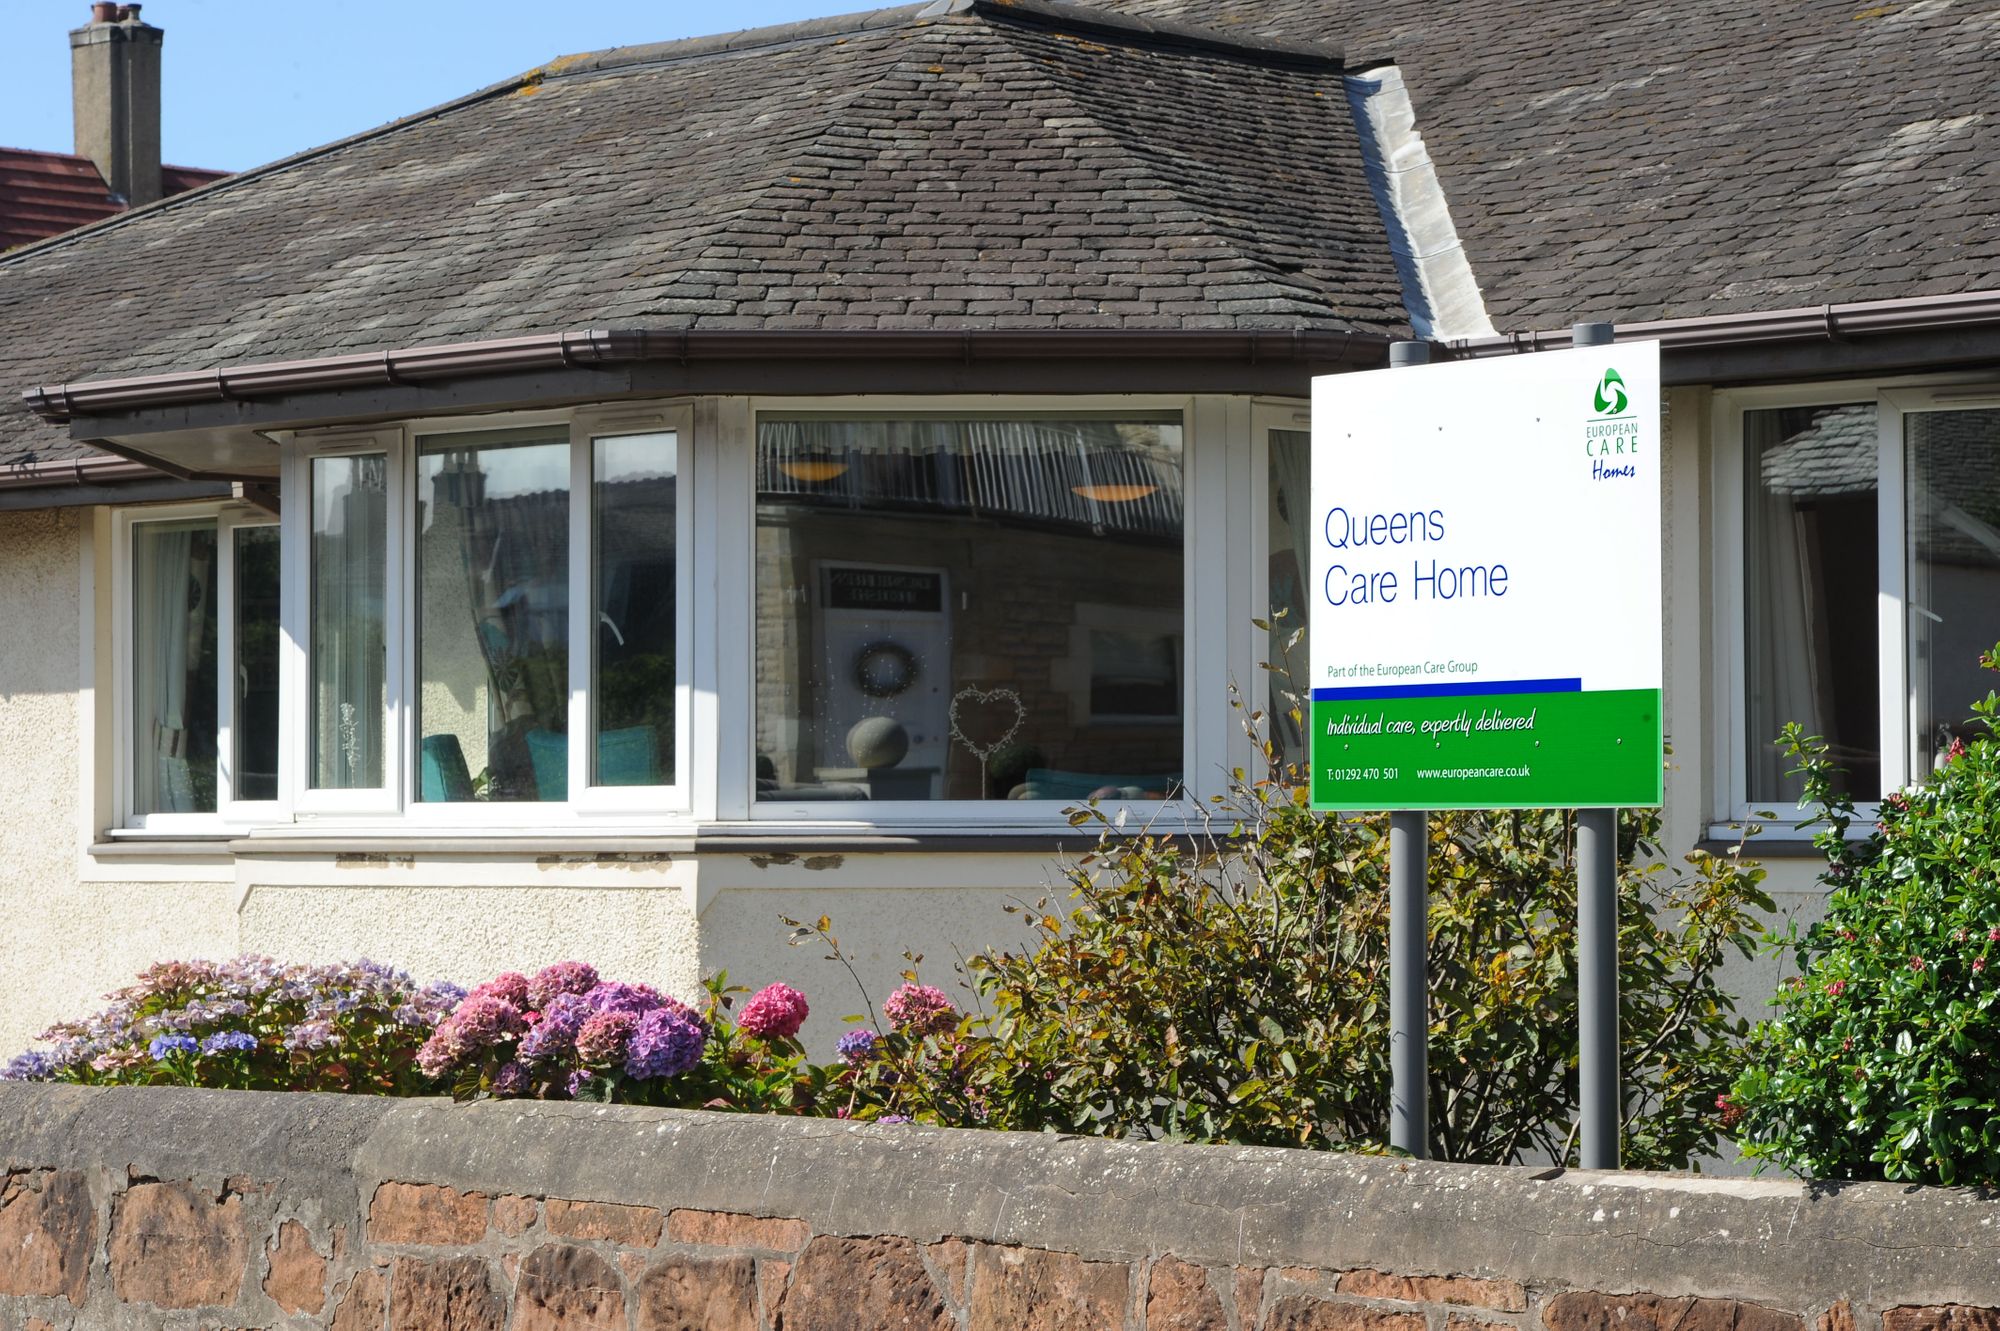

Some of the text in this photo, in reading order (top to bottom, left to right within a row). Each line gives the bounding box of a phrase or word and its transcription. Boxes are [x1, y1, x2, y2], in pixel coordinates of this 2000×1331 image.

[1586, 422, 1638, 438] EUROPEAN
[1586, 436, 1638, 457] CARE
[1592, 458, 1636, 482] Homes
[1325, 507, 1445, 549] Queens
[1325, 559, 1508, 606] Care Home
[1327, 660, 1478, 678] Part of the European Care Group
[1327, 707, 1537, 739] Individual care, expertly delivered
[1363, 768, 1380, 780] 470
[1383, 767, 1399, 780] 501
[1417, 764, 1531, 781] www.europeancare.co.uk
